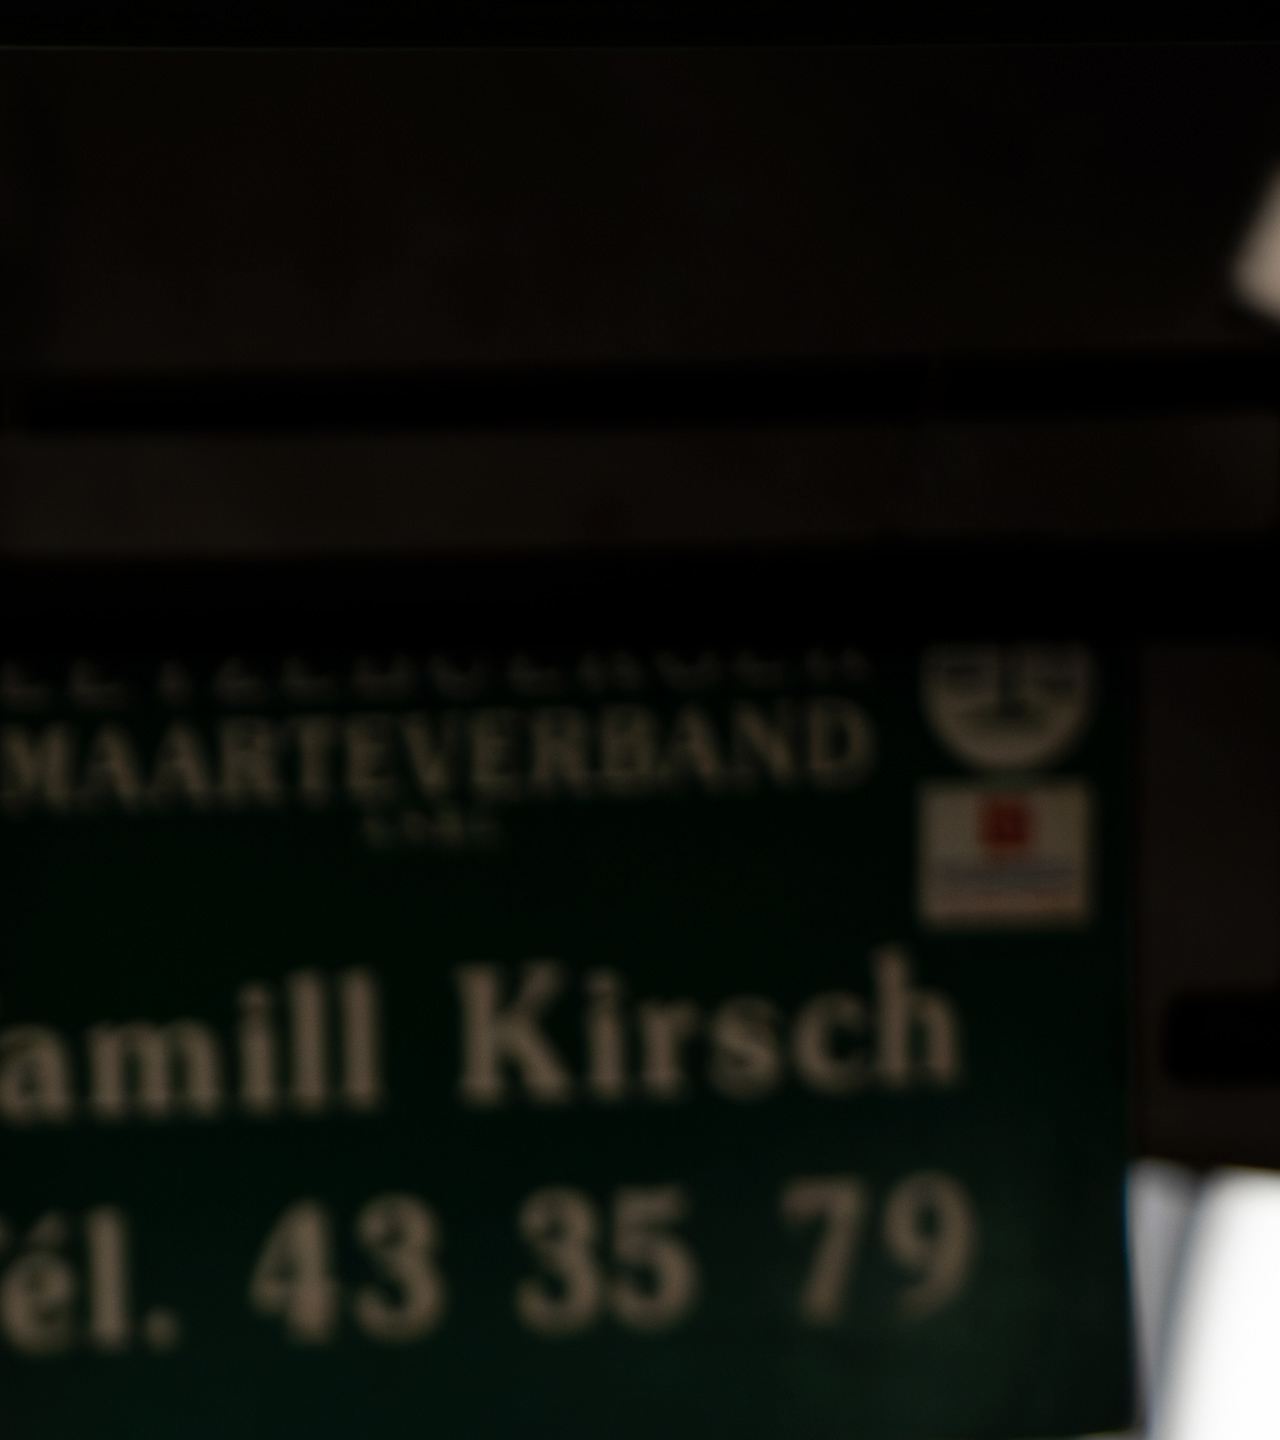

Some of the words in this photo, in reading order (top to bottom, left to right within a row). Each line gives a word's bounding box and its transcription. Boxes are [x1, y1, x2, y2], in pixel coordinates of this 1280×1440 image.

[452, 943, 964, 1108] Kirsch
[249, 1190, 446, 1342] 43
[516, 1186, 701, 1336] 35
[780, 1172, 976, 1325] 79
